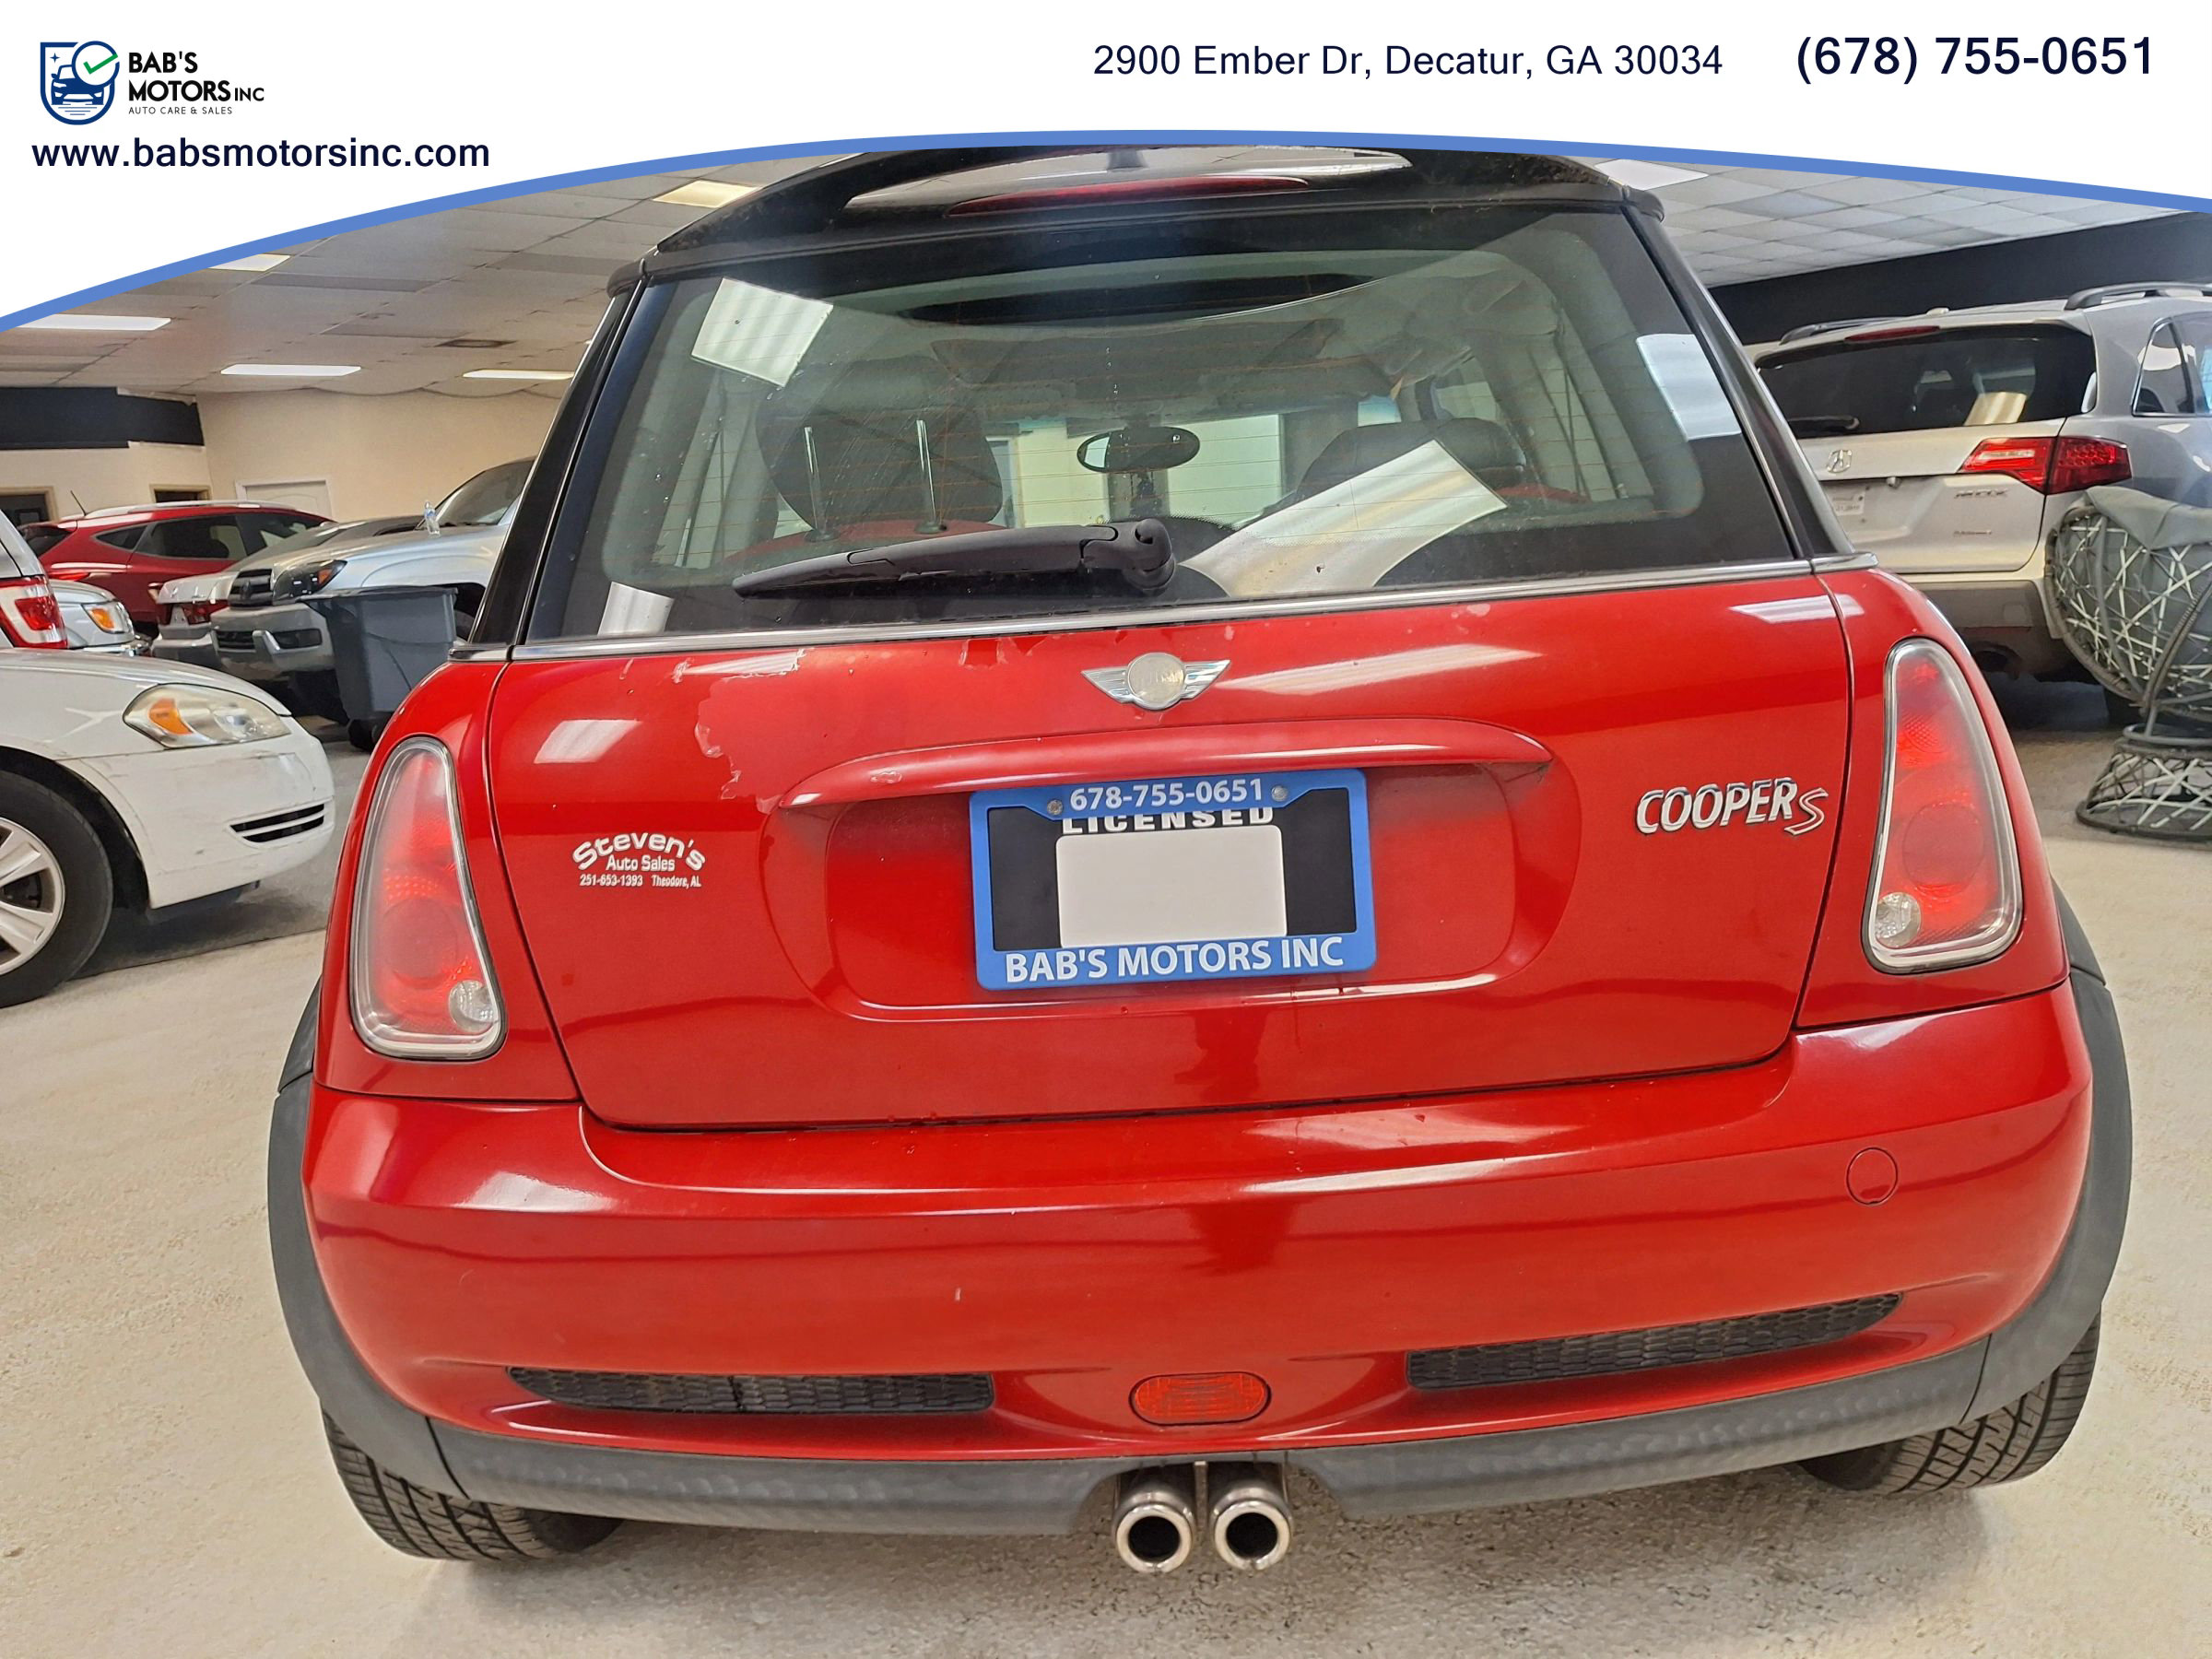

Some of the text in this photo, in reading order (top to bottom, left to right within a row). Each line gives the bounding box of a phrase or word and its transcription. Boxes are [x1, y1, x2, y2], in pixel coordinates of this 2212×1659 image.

[1069, 778, 1263, 812] 678-755-0651
[1636, 776, 1830, 836] COOPER S
[1062, 806, 1273, 835] LICENSED
[572, 832, 706, 870] Steven's
[606, 854, 676, 872] Auto Sales
[579, 874, 701, 889] 251-653-1393 Theodore, AL
[1006, 935, 1344, 983] BAB'S MOTORS INC
